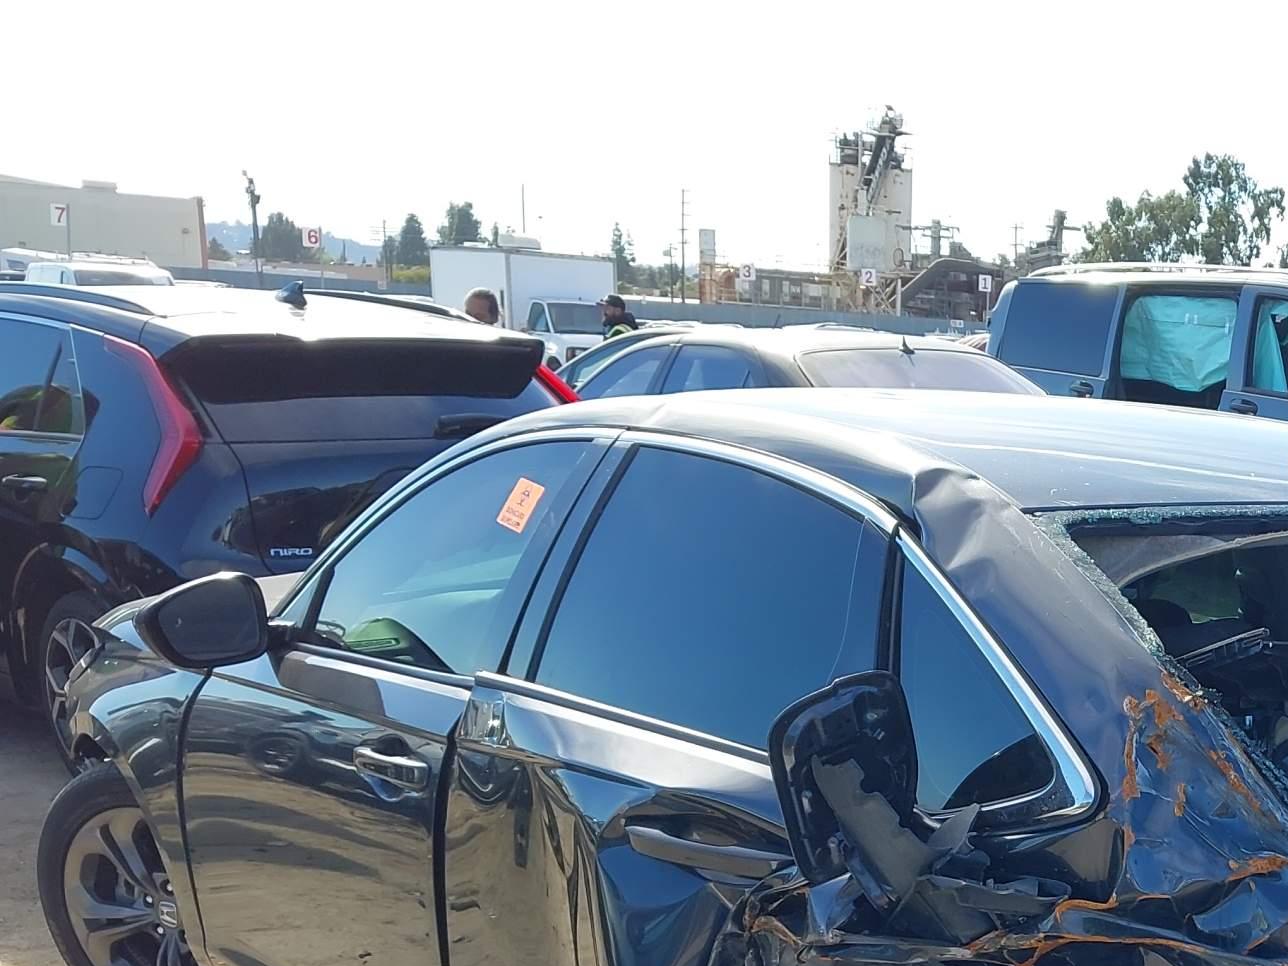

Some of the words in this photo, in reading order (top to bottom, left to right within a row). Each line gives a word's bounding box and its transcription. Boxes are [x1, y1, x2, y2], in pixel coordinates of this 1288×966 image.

[55, 206, 66, 223] 7
[307, 229, 319, 244] 6
[743, 265, 752, 278] 3
[865, 270, 873, 283] 2
[981, 277, 988, 290] 1
[270, 547, 313, 556] NIRO
